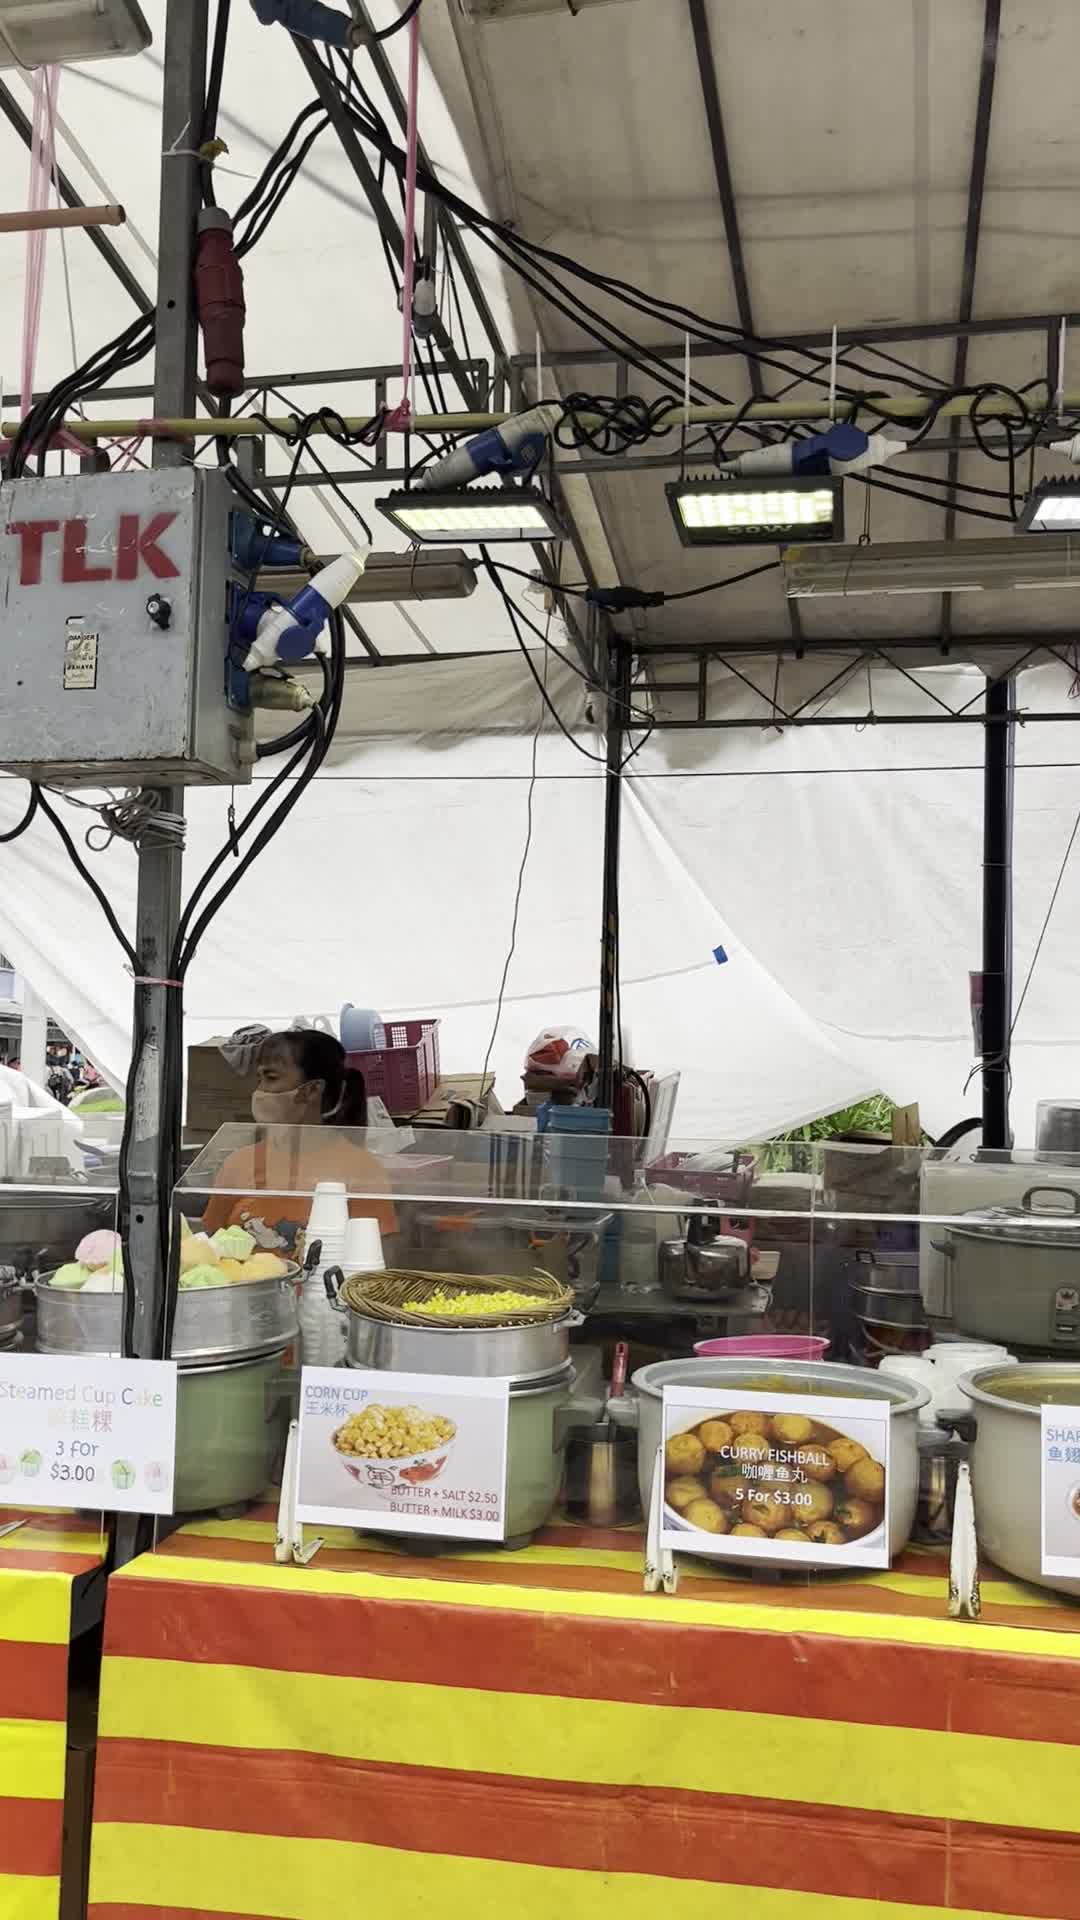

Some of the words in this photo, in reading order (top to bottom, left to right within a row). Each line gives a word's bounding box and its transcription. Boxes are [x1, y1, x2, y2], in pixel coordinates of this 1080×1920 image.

[5, 512, 181, 586] TLK
[0, 1382, 76, 1401] Steamed
[82, 1385, 116, 1407] Cup
[305, 1385, 340, 1400] CORN
[343, 1388, 368, 1401] CUP
[49, 1408, 113, 1432] 糕粿
[56, 1440, 65, 1456] 3
[720, 1445, 766, 1460] CURRY
[768, 1449, 830, 1466] FISHBALL
[50, 1462, 95, 1482] $3.00
[742, 1463, 808, 1483] 咖喱鱼丸
[391, 1486, 431, 1498] BUTTER
[442, 1489, 466, 1501] SALT
[468, 1491, 498, 1504] $2.50
[735, 1488, 744, 1500] 5
[748, 1489, 770, 1503] For
[774, 1490, 812, 1505] $3.00
[390, 1502, 430, 1515] BUTTER
[441, 1506, 468, 1519] MILK
[469, 1508, 500, 1522] $3.00
